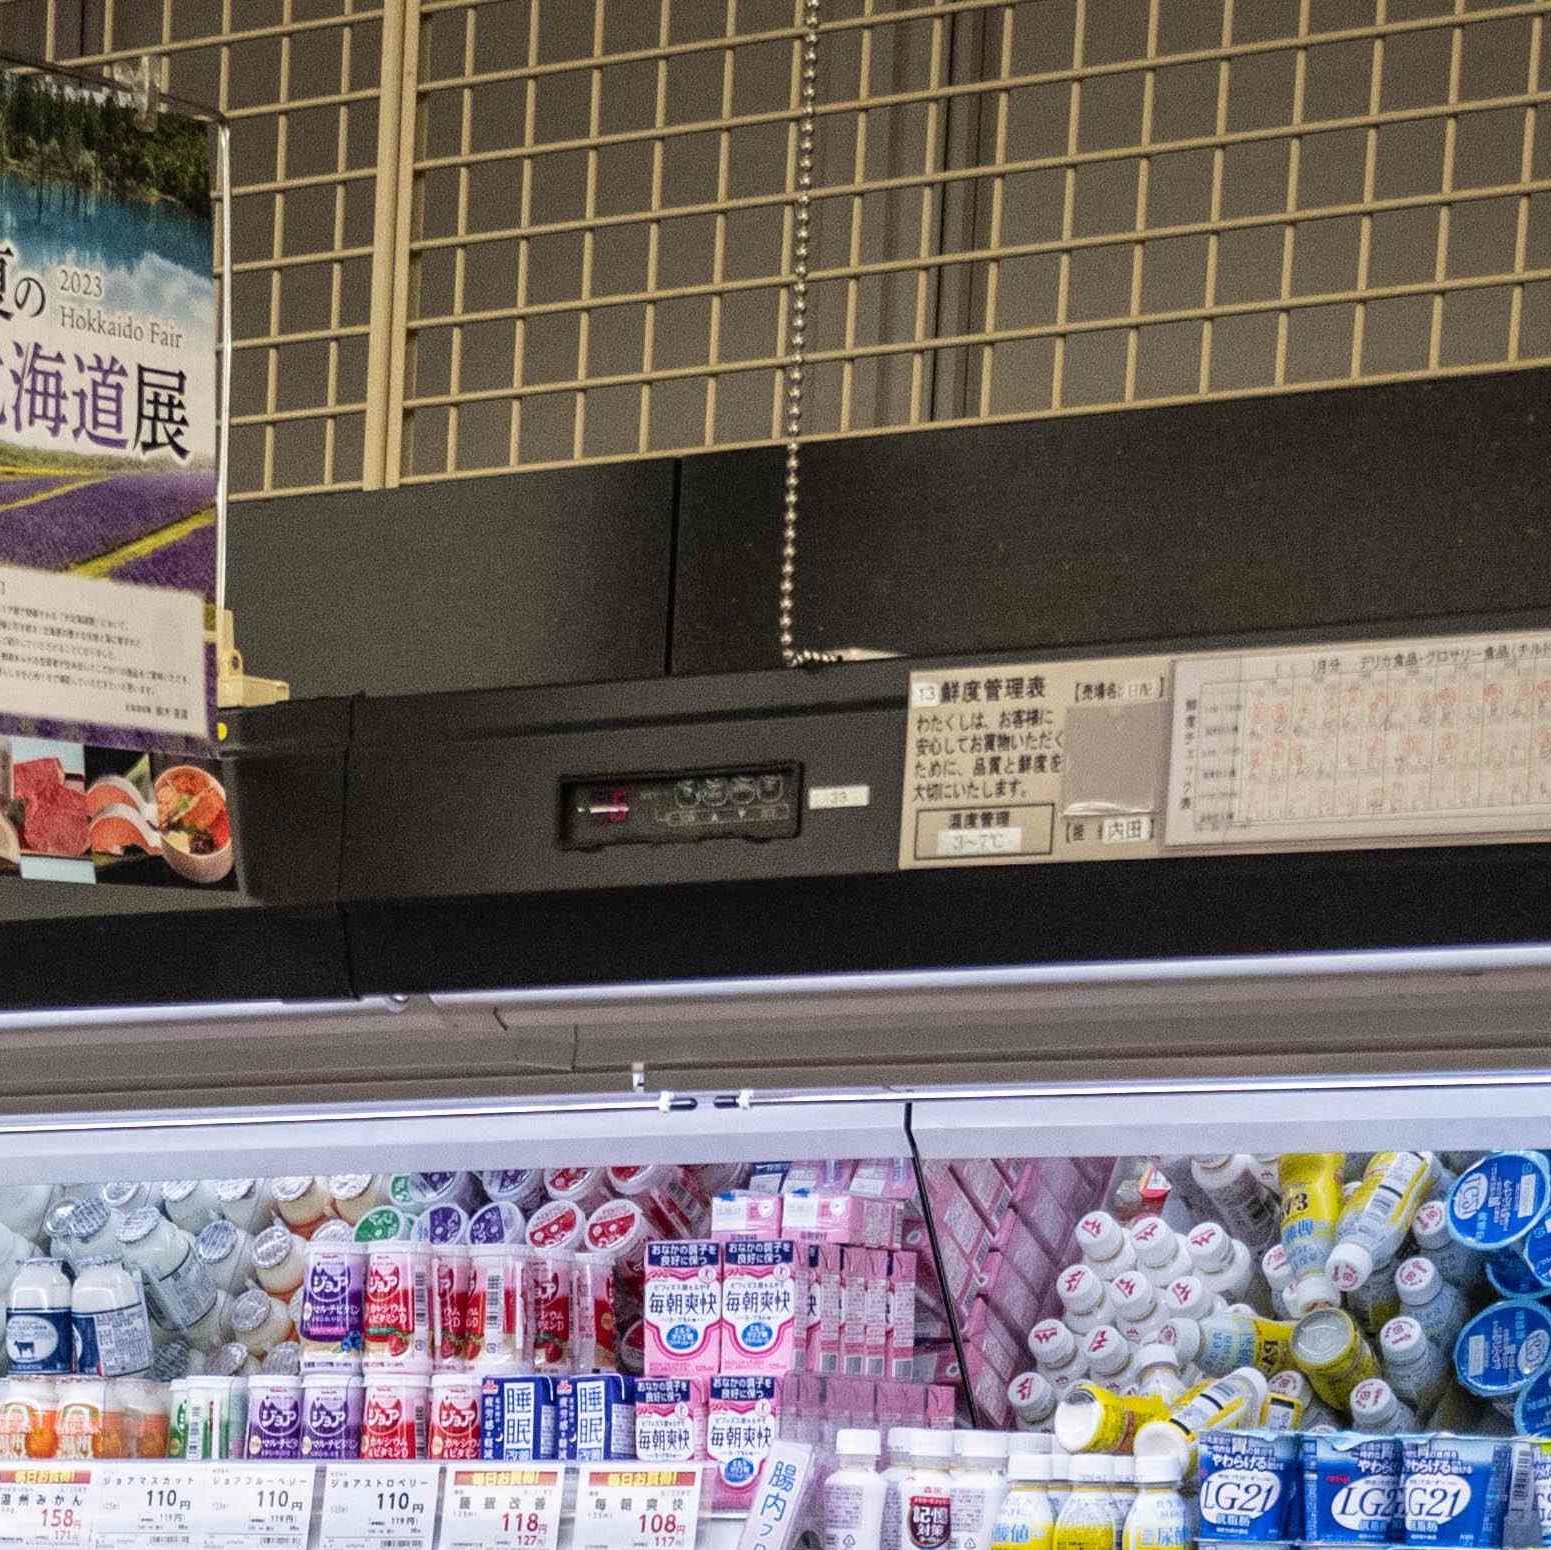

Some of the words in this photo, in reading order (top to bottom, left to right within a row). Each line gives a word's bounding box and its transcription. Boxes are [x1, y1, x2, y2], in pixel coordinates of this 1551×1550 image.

[60, 269, 103, 299] 2023
[60, 305, 145, 344] Hokkaido
[150, 321, 183, 352] Fair
[940, 675, 1046, 703] 鮮度管理表
[648, 1291, 716, 1316] 毎朝爽快
[724, 1290, 790, 1316] 毎朝爽快
[502, 1382, 534, 1446] 睡眠
[578, 1380, 605, 1446] 睡眠
[710, 1423, 773, 1450] 毎朝爽快
[212, 1476, 308, 1488] ジョアブルーベリー
[330, 1478, 429, 1489] ジョアストロベリー
[145, 1488, 192, 1510] 110円
[256, 1490, 303, 1510] 110円
[376, 1492, 425, 1512] 110円
[500, 1512, 548, 1534] 118円
[638, 1514, 686, 1535] 108円
